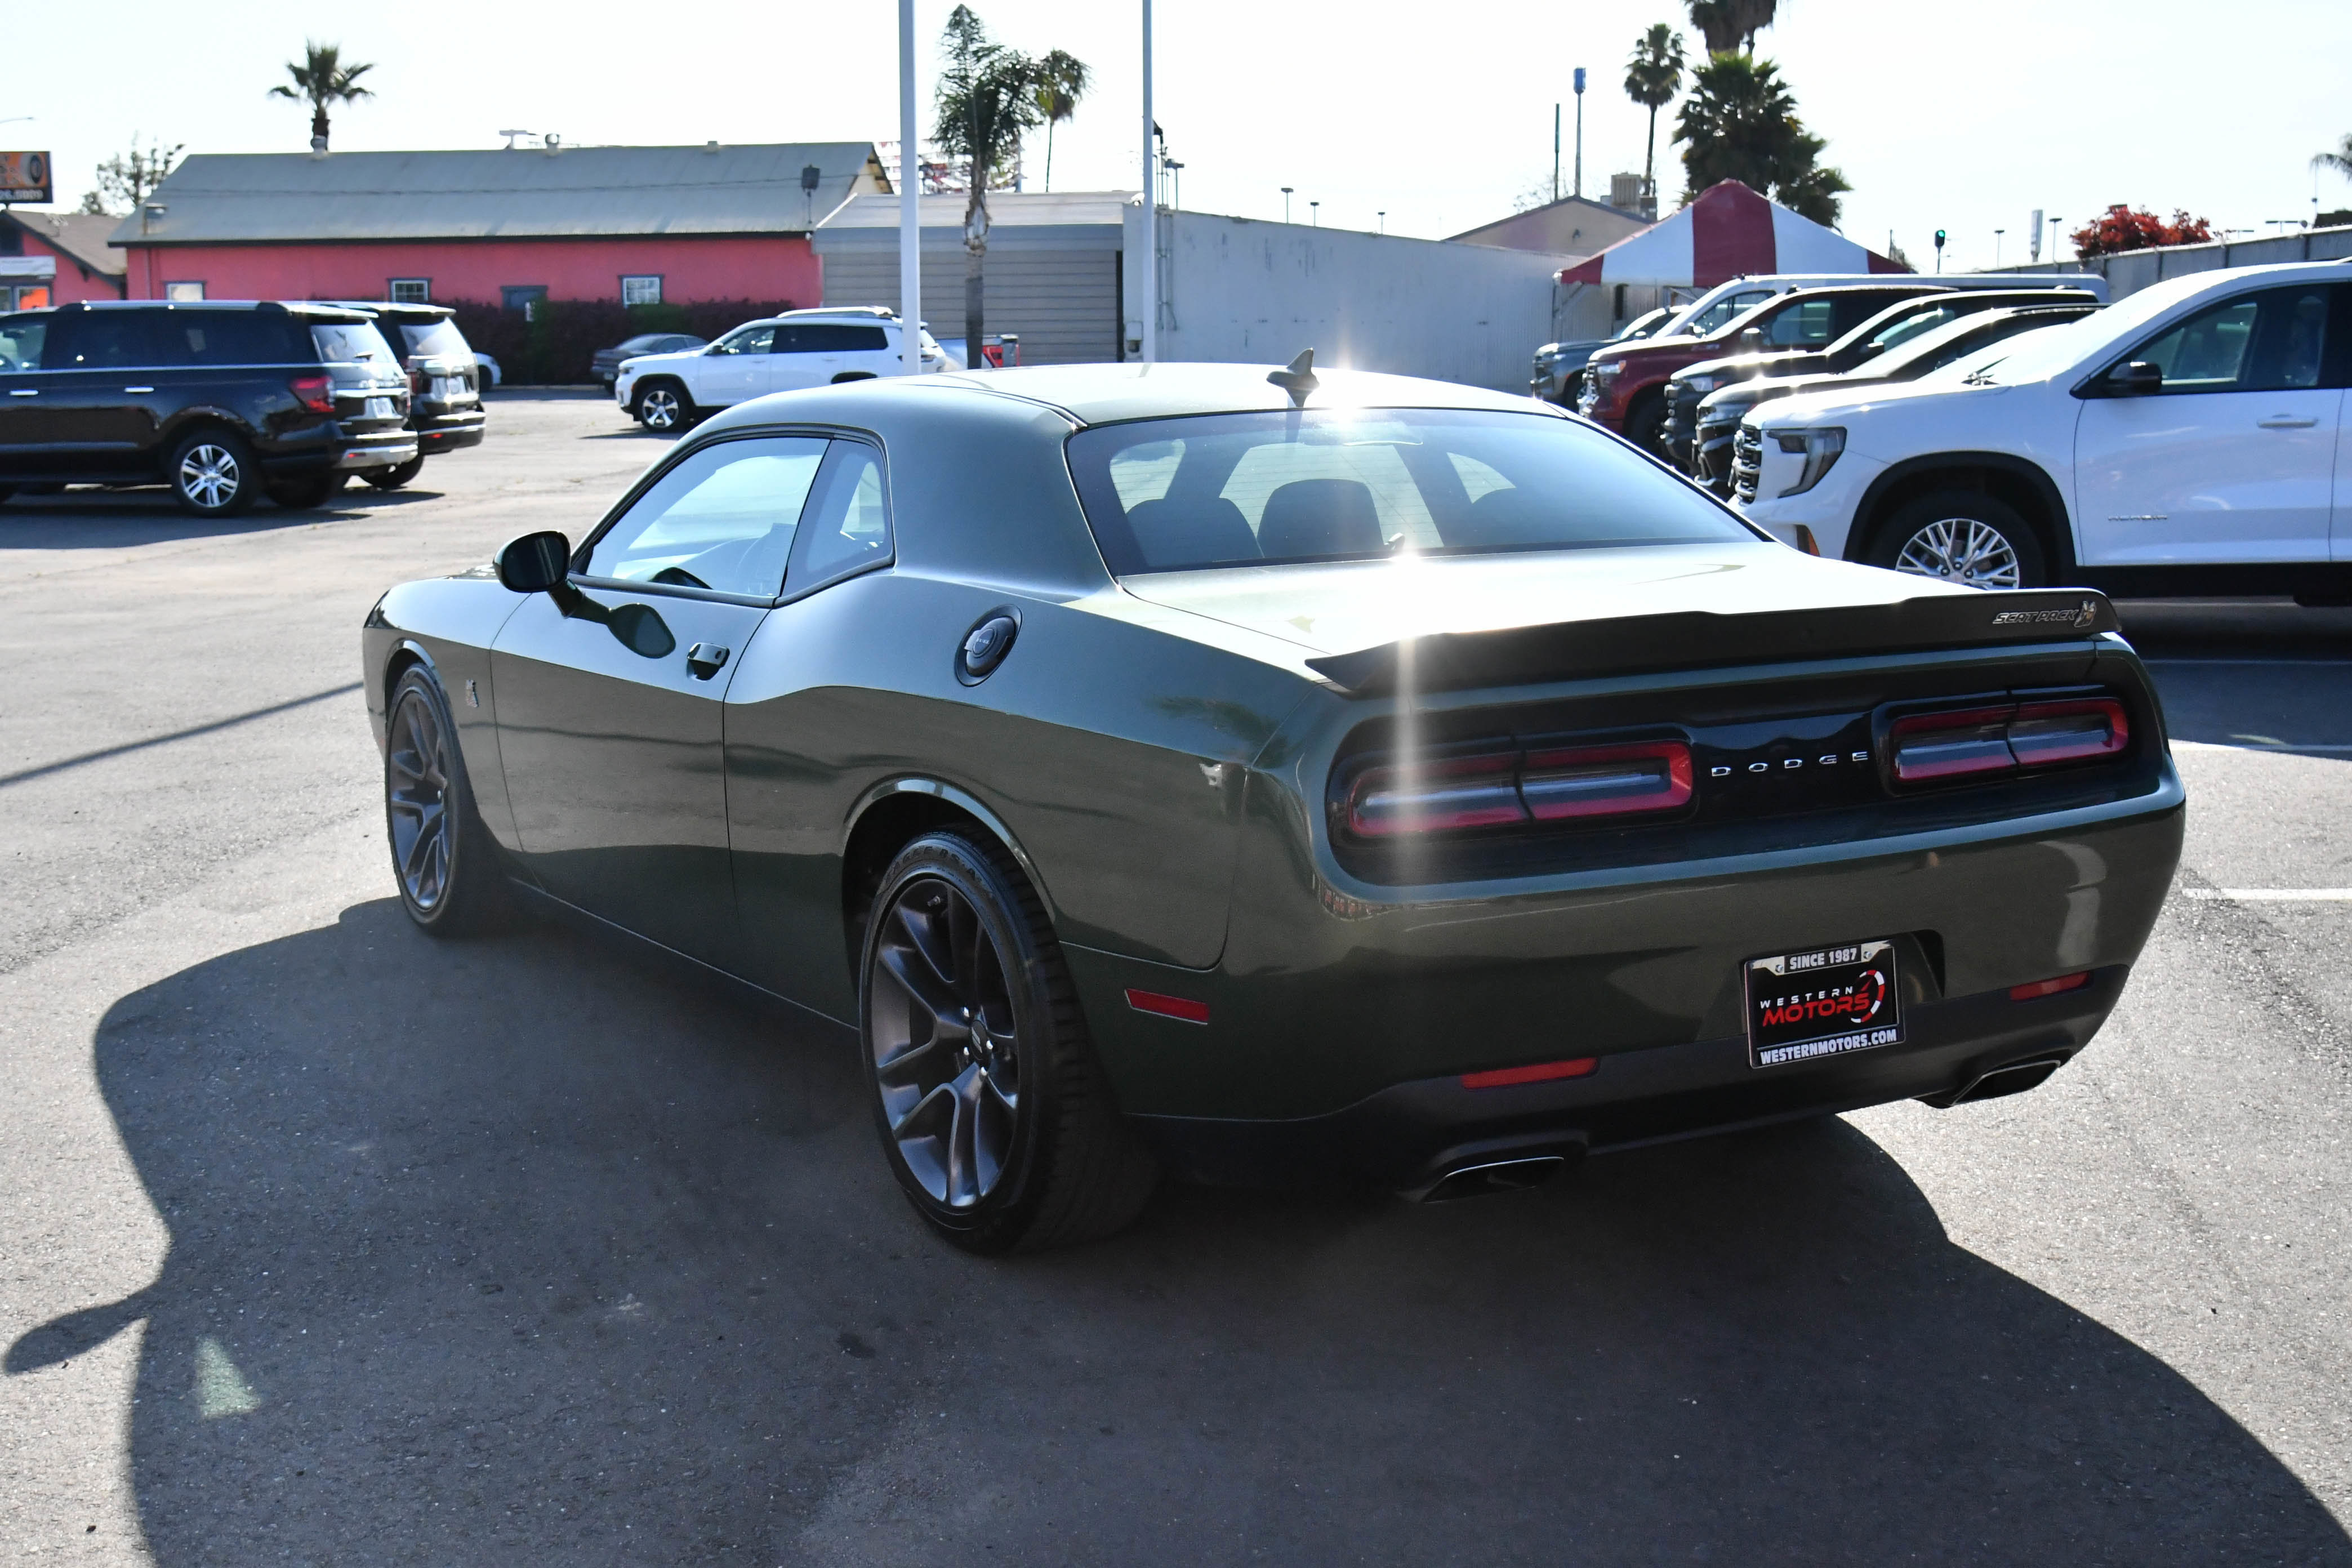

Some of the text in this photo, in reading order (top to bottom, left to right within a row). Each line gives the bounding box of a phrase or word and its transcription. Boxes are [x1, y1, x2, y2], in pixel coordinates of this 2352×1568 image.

[1711, 751, 1868, 777] DODGE
[1789, 947, 1857, 970] SINCE 1987
[1760, 986, 1854, 1009] WESTERN
[1762, 992, 1870, 1027] MOTORS
[1759, 1028, 1897, 1065] WESTERNMOTORS.COM
